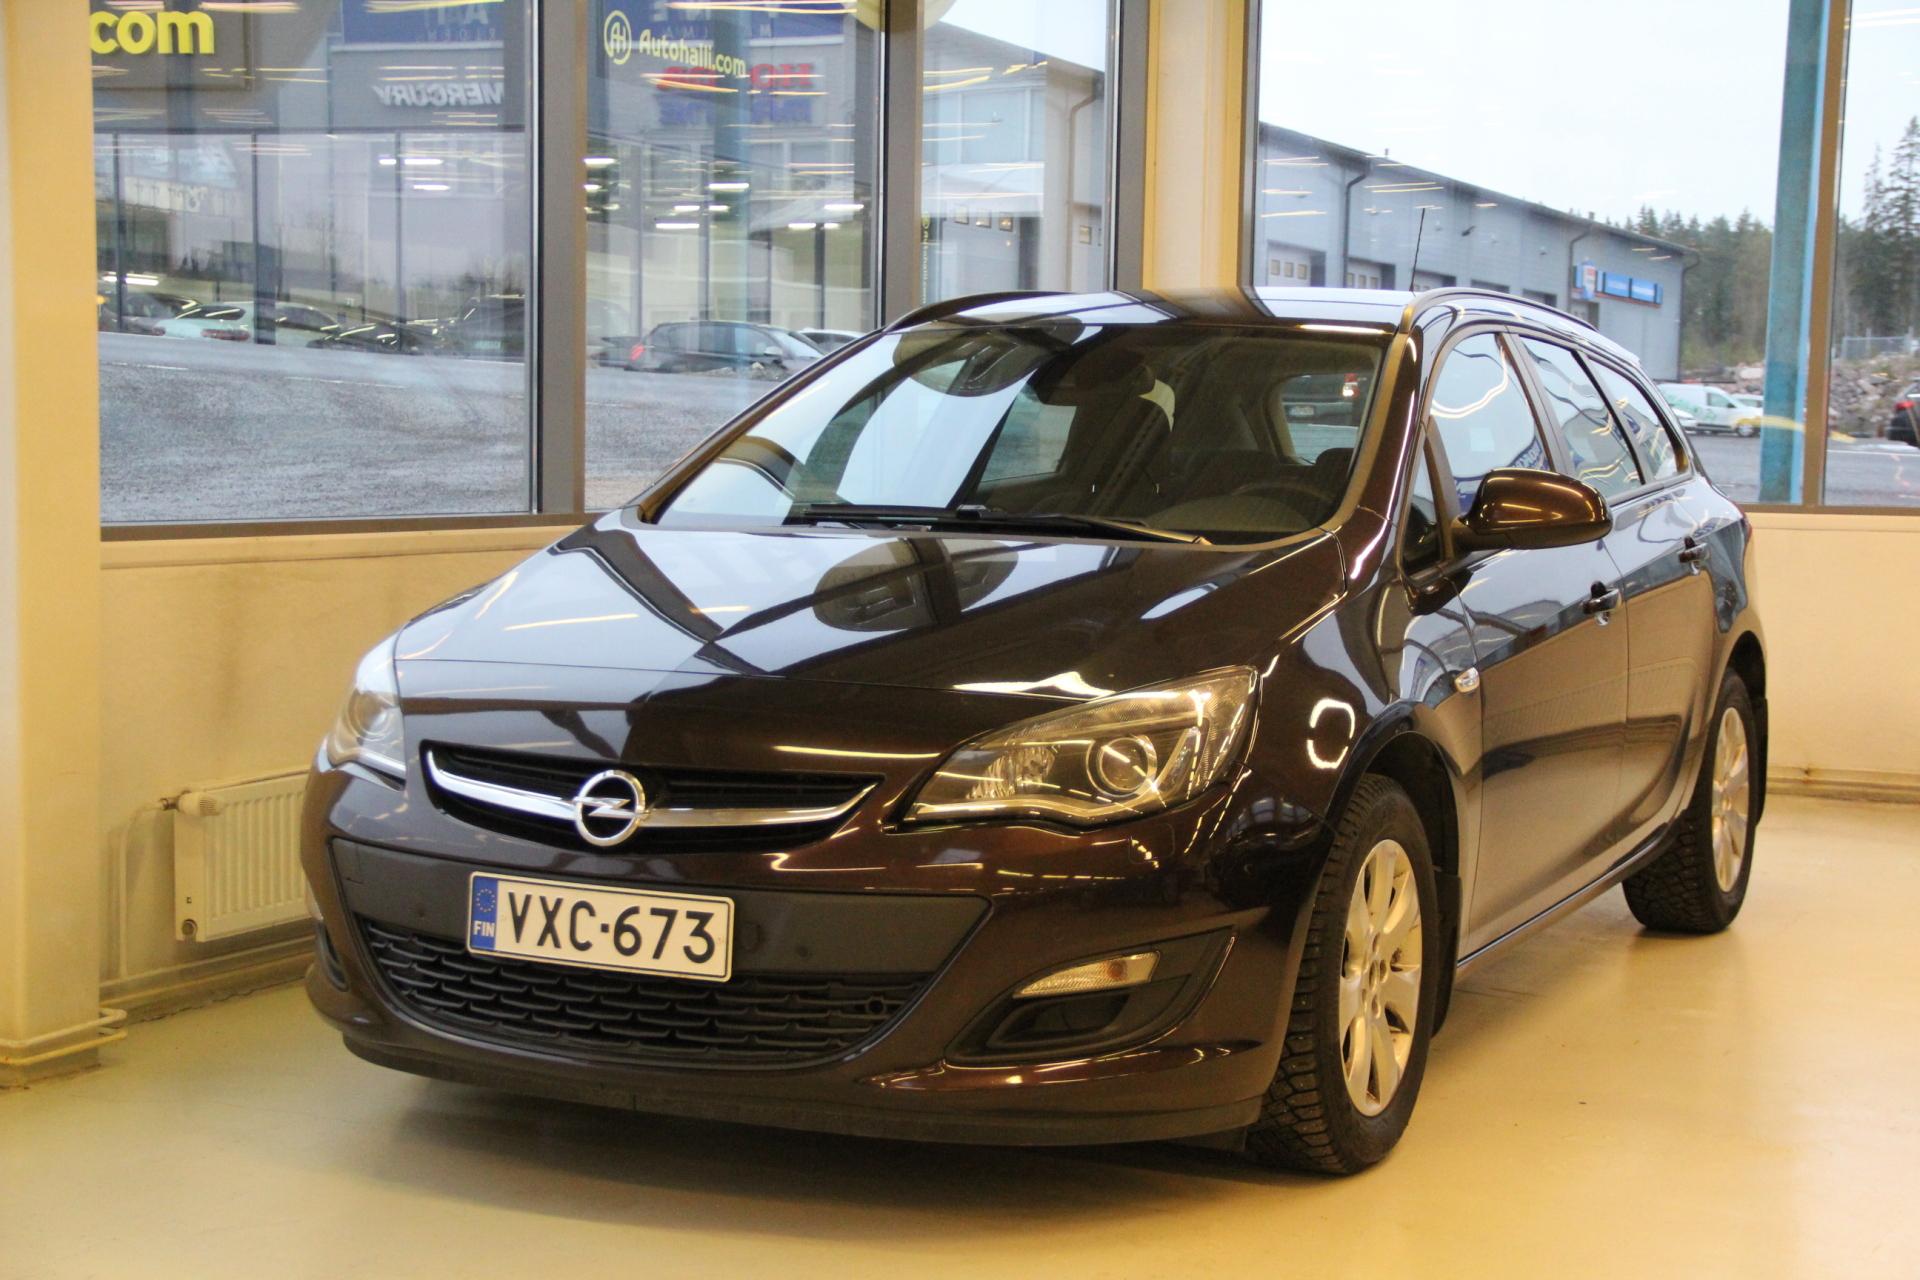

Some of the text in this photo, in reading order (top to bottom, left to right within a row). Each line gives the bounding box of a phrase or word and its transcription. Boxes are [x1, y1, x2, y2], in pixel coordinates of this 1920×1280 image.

[90, 11, 215, 54] com
[639, 29, 746, 77] Autohalli.com
[473, 920, 496, 938] FIN
[508, 891, 715, 964] VXC-673
